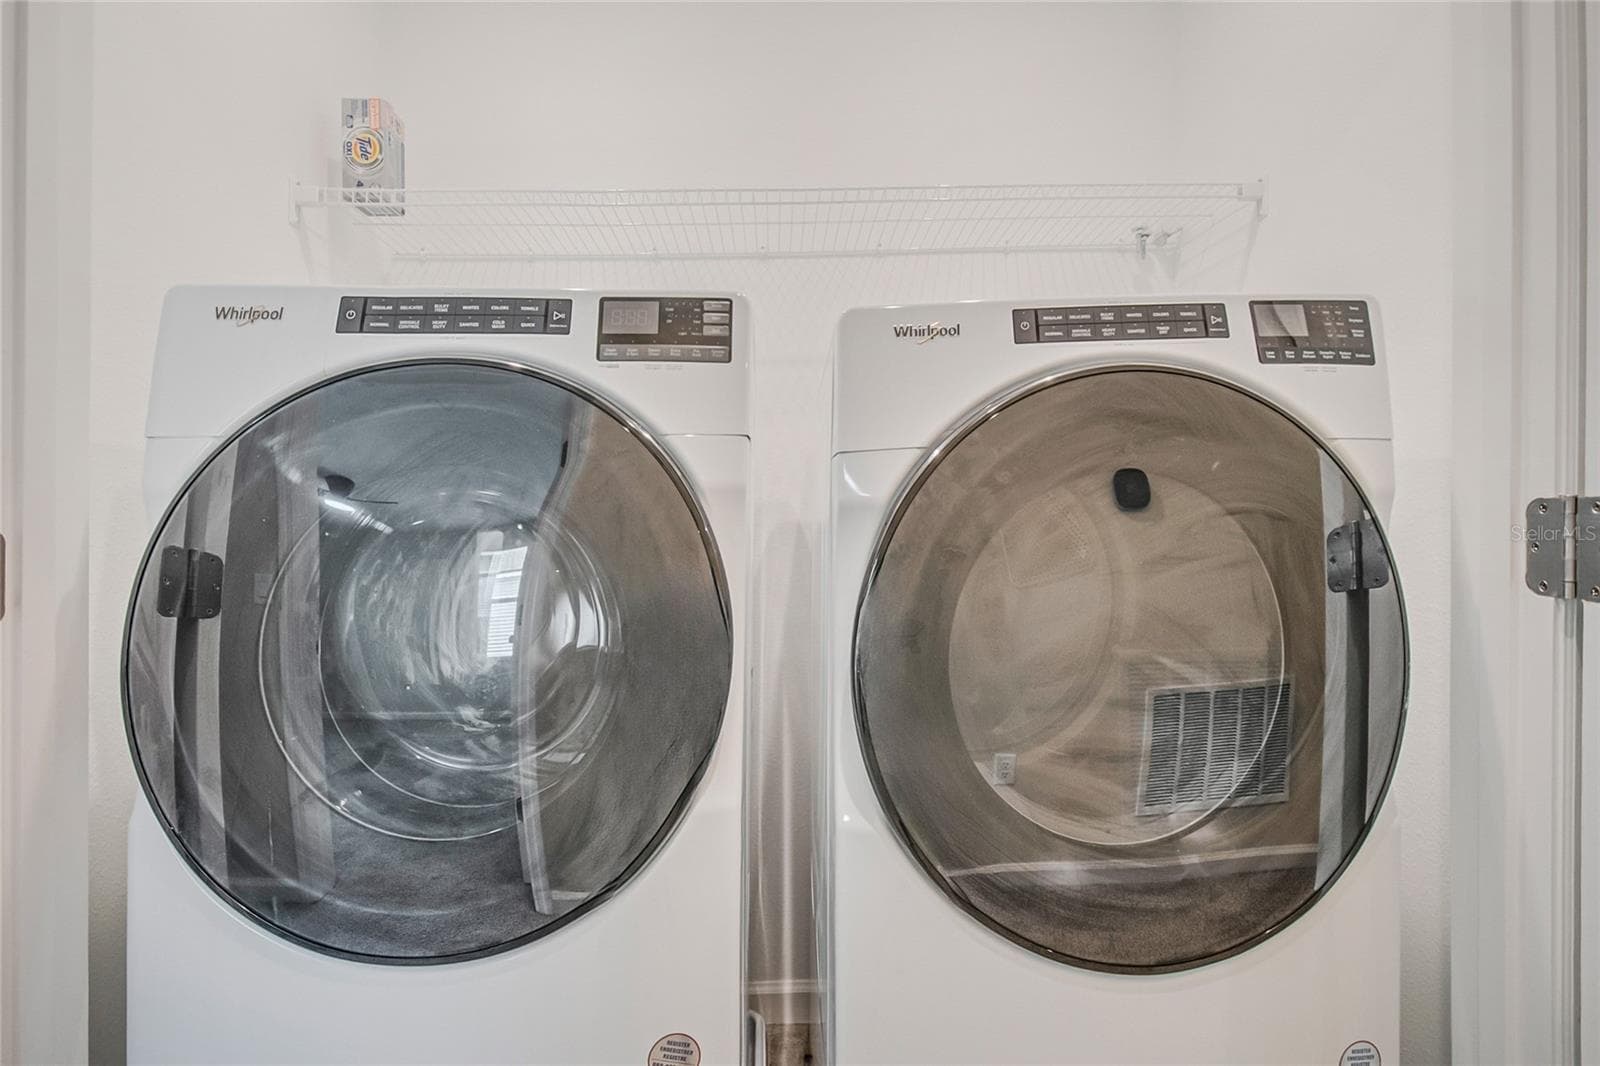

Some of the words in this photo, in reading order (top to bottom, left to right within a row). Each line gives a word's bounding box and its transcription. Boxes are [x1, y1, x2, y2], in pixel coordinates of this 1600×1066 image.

[345, 141, 353, 156] OXI
[355, 137, 372, 160] Tide
[215, 306, 284, 324] Whirlpool
[894, 323, 960, 340] Whirlpool
[666, 1040, 691, 1048] REGISTER
